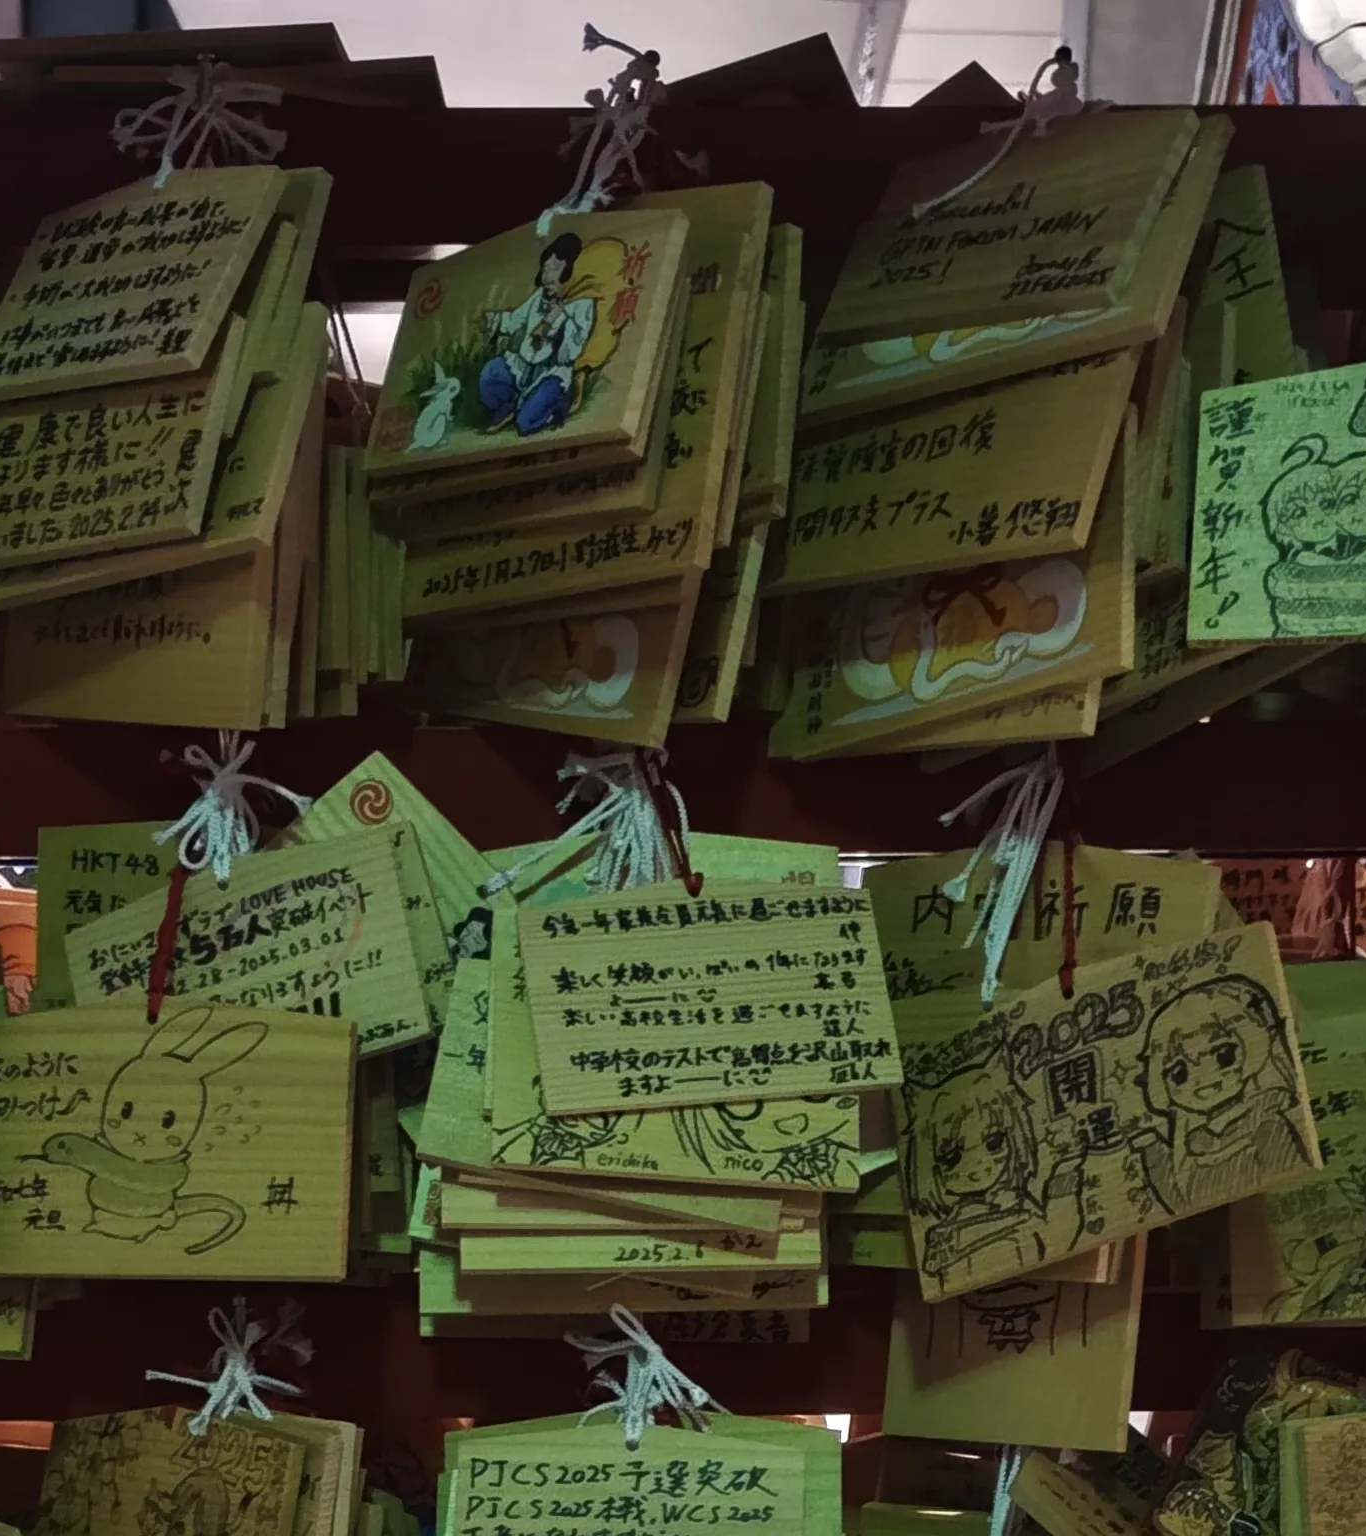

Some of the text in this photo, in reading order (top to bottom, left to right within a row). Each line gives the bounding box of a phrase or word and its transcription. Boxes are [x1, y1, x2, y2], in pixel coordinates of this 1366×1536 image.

[238, 865, 356, 915] LOVE HOUSE
[912, 880, 1163, 938] 内祈願
[724, 1152, 765, 1173] nico
